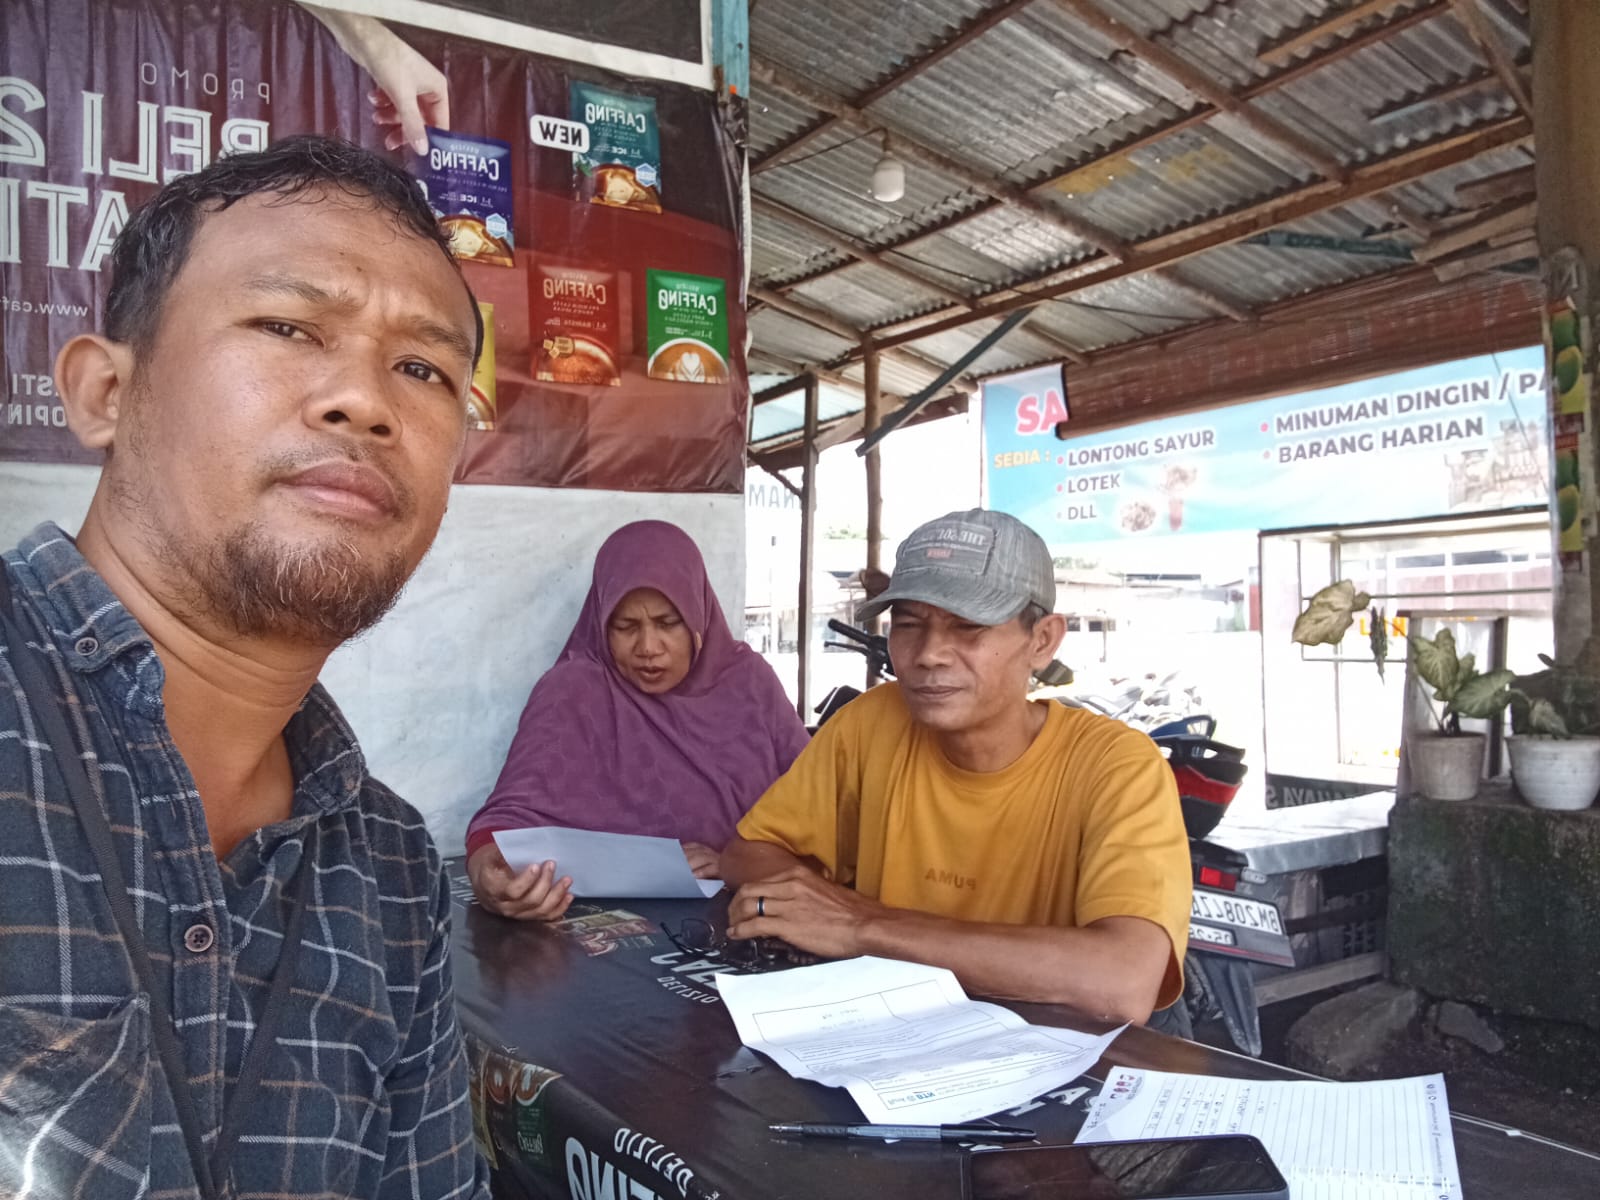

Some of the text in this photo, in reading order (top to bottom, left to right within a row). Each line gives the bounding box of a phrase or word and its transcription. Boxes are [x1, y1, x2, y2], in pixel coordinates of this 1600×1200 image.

[1275, 397, 1389, 434] MINUMAN
[1396, 379, 1490, 414] DINGIN
[1067, 430, 1215, 467] LONTONG SAYUR
[1278, 415, 1484, 464] BARANG HARIAN
[994, 450, 1041, 468] SEDIA
[1067, 473, 1121, 493] LOTEK
[1067, 504, 1098, 520] DLL
